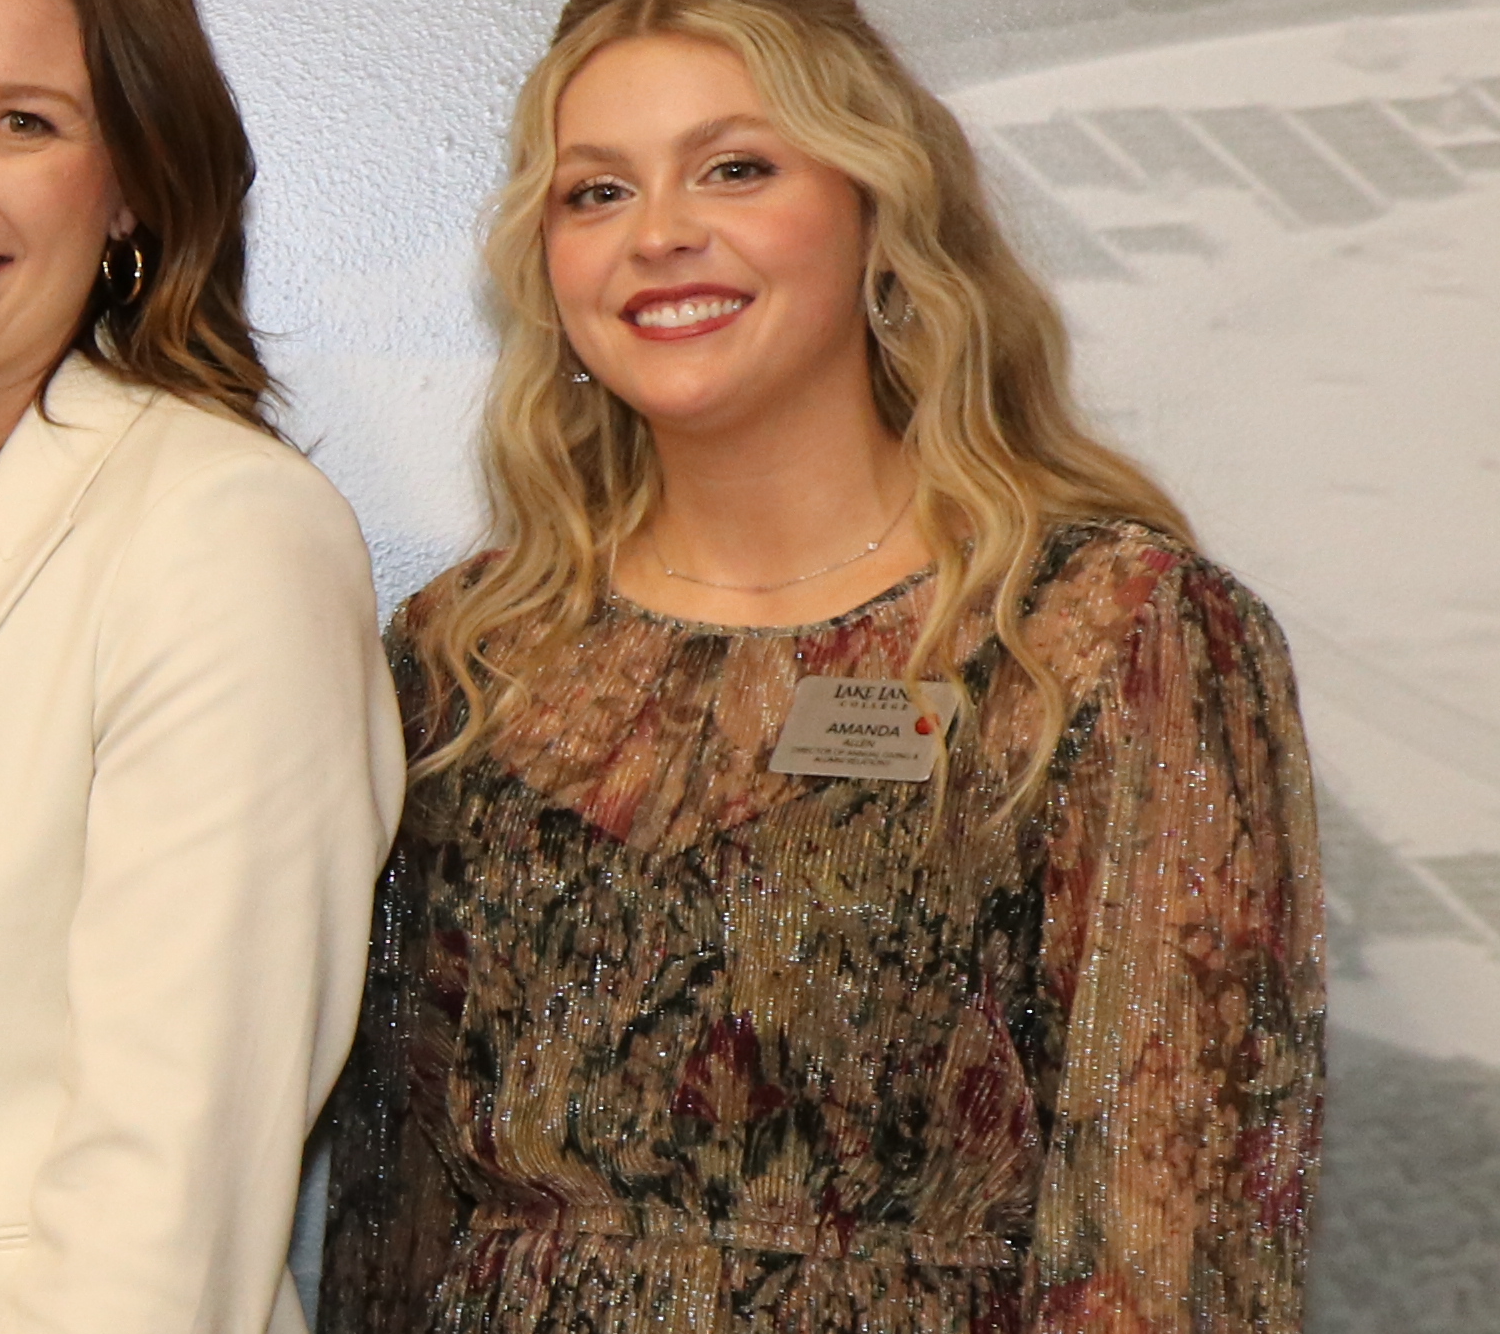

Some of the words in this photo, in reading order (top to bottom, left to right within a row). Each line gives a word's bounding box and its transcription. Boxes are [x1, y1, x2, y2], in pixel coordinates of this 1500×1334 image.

[834, 684, 875, 700] LAKE
[879, 686, 912, 702] LAN
[839, 700, 909, 711] COLLEGE
[825, 722, 901, 737] AMANDA
